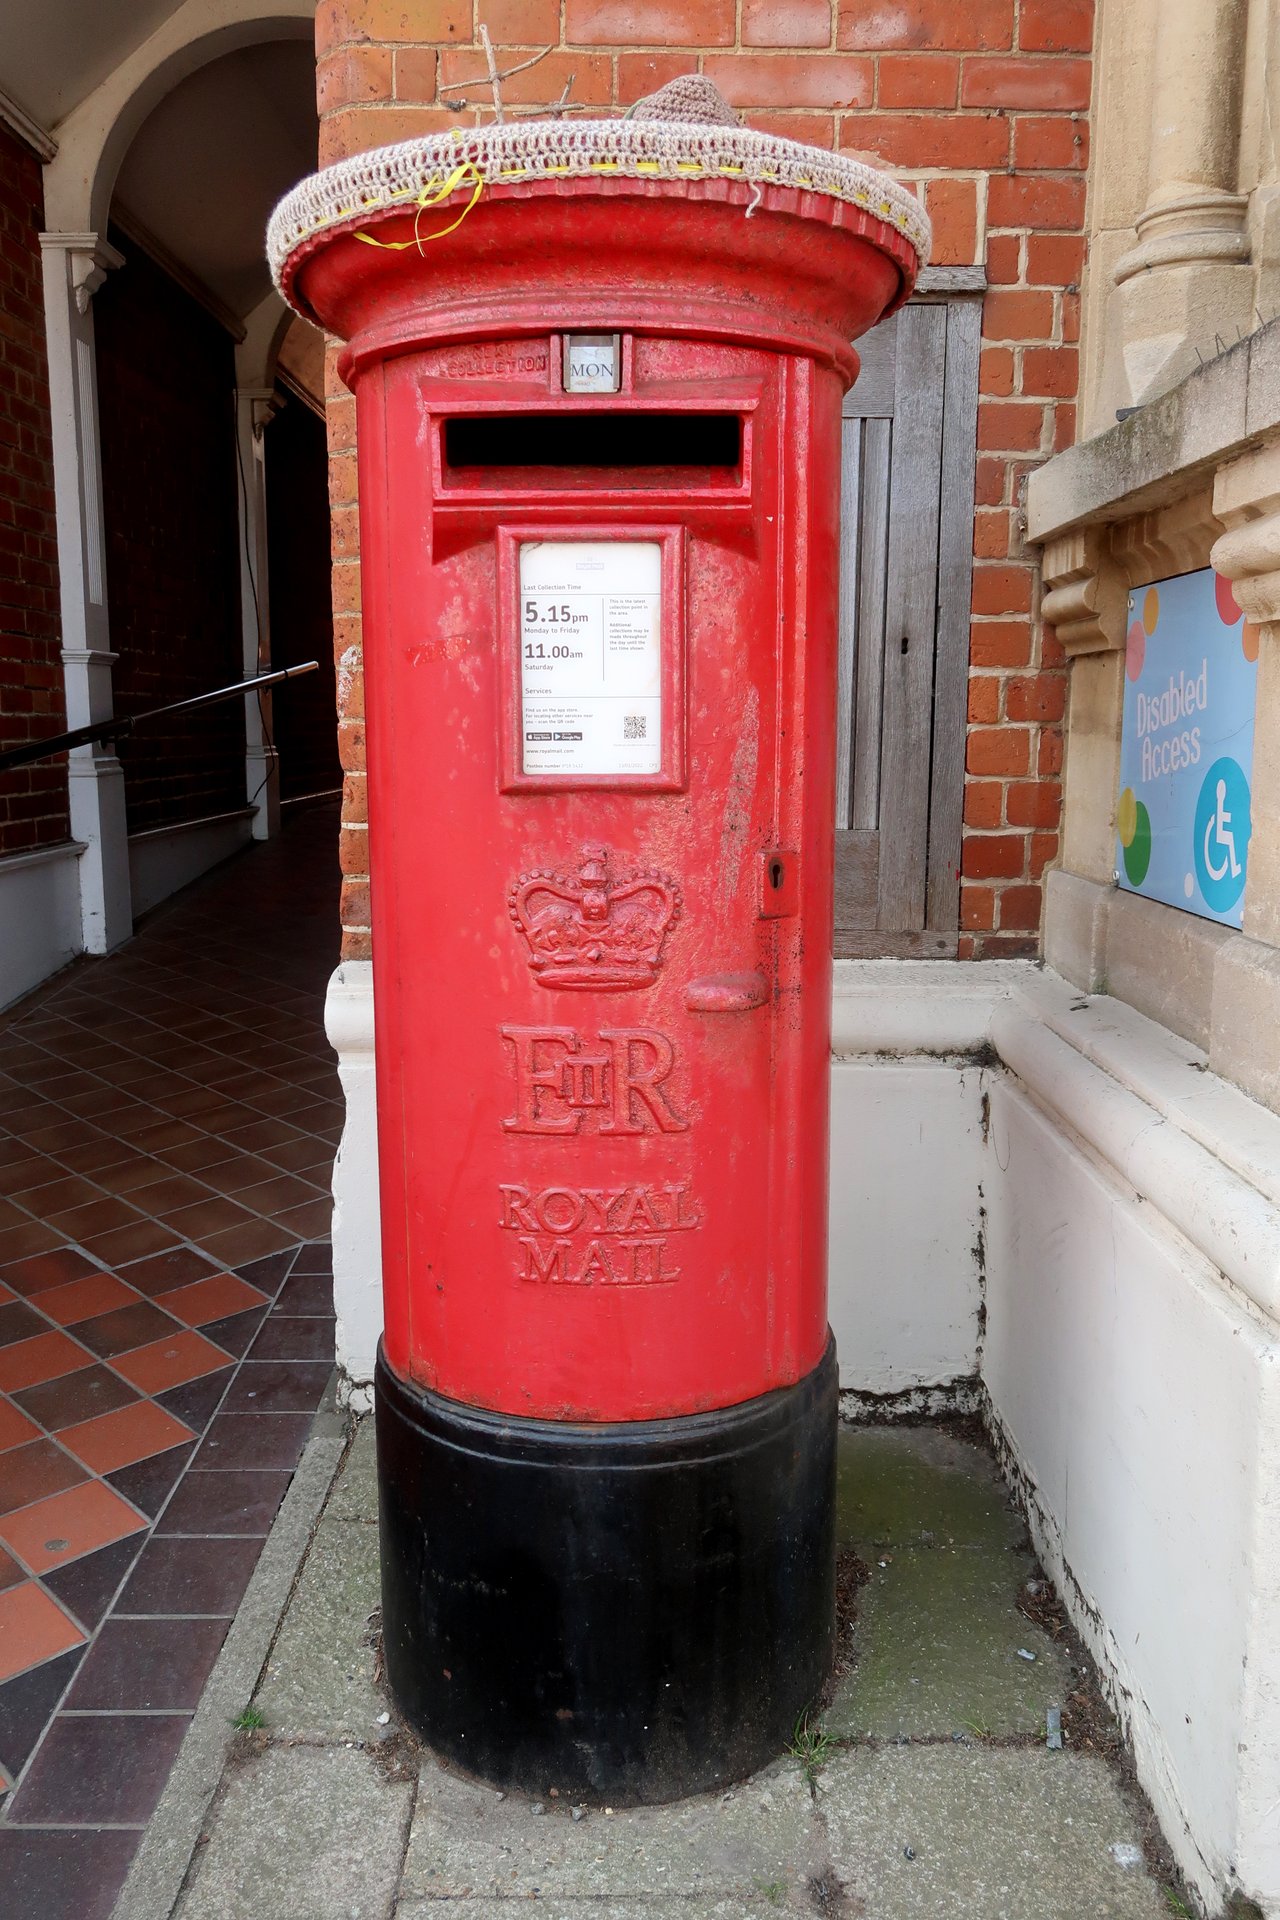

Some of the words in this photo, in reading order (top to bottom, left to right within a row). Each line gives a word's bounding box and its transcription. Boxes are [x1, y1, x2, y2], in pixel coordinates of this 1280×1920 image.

[447, 354, 547, 377] COLLECTION
[570, 363, 613, 377] MON
[525, 601, 589, 624] 5.15pm
[525, 643, 583, 658] 11.00am
[1136, 656, 1208, 738] Disabled
[1142, 726, 1202, 783] Access
[498, 1184, 703, 1235] ROYAL
[518, 1237, 682, 1287] MAIL
